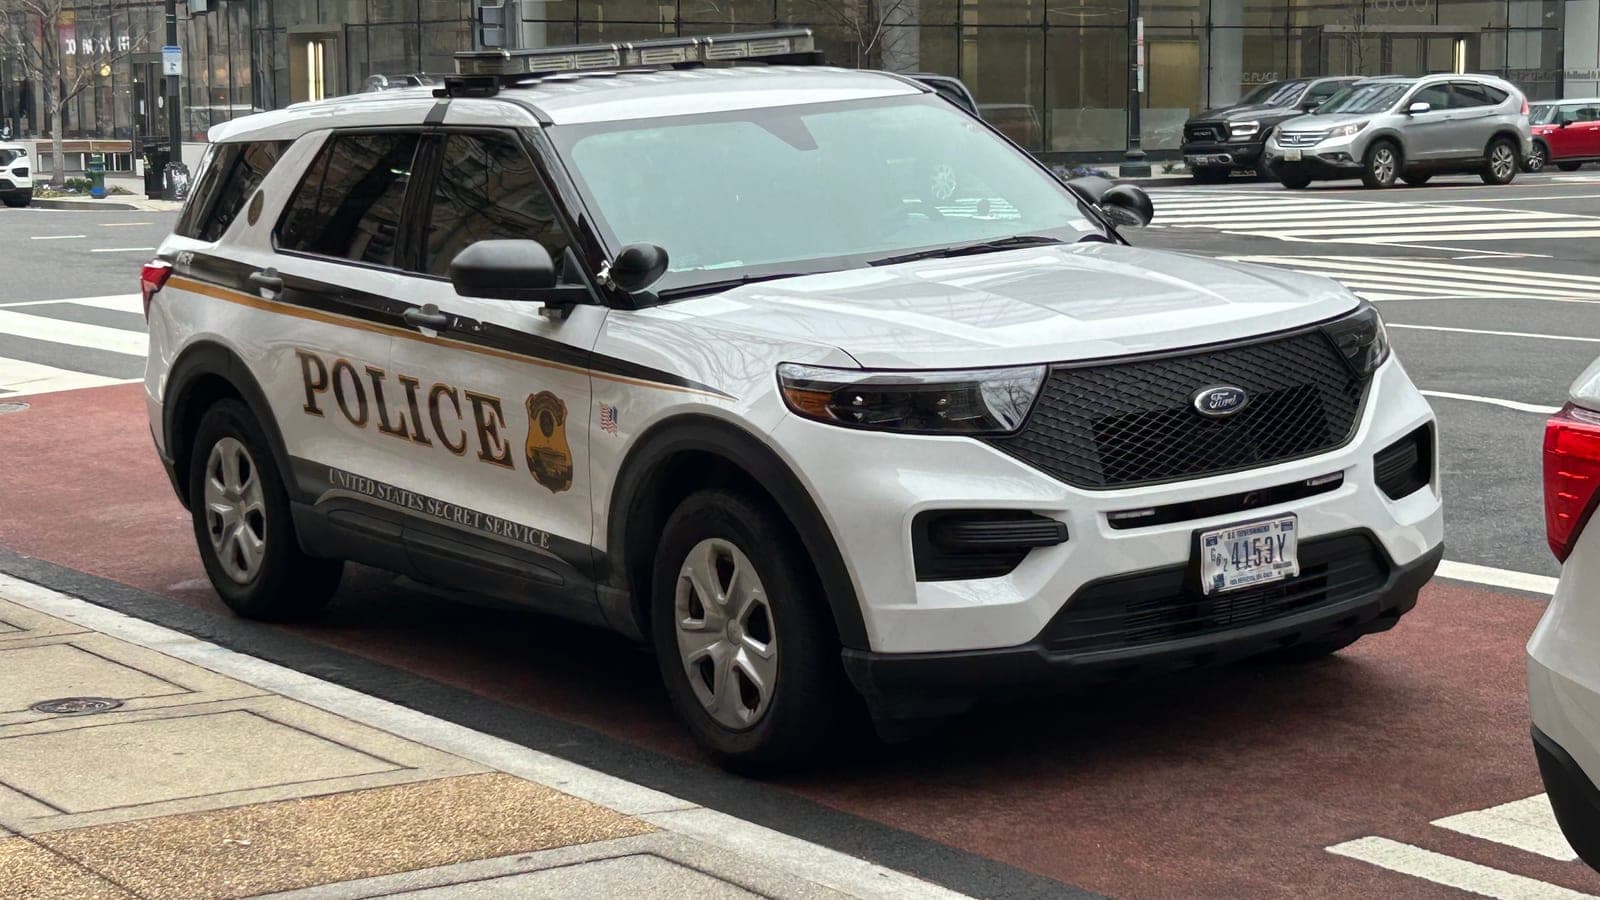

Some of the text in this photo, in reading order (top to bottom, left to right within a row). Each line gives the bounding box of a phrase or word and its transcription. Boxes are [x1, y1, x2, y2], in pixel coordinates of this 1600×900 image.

[295, 347, 515, 470] POLICE
[1210, 392, 1237, 409] Ford
[329, 468, 550, 550] UNITED STATES SECRET SERVICE
[1231, 533, 1286, 571] 4153Y
